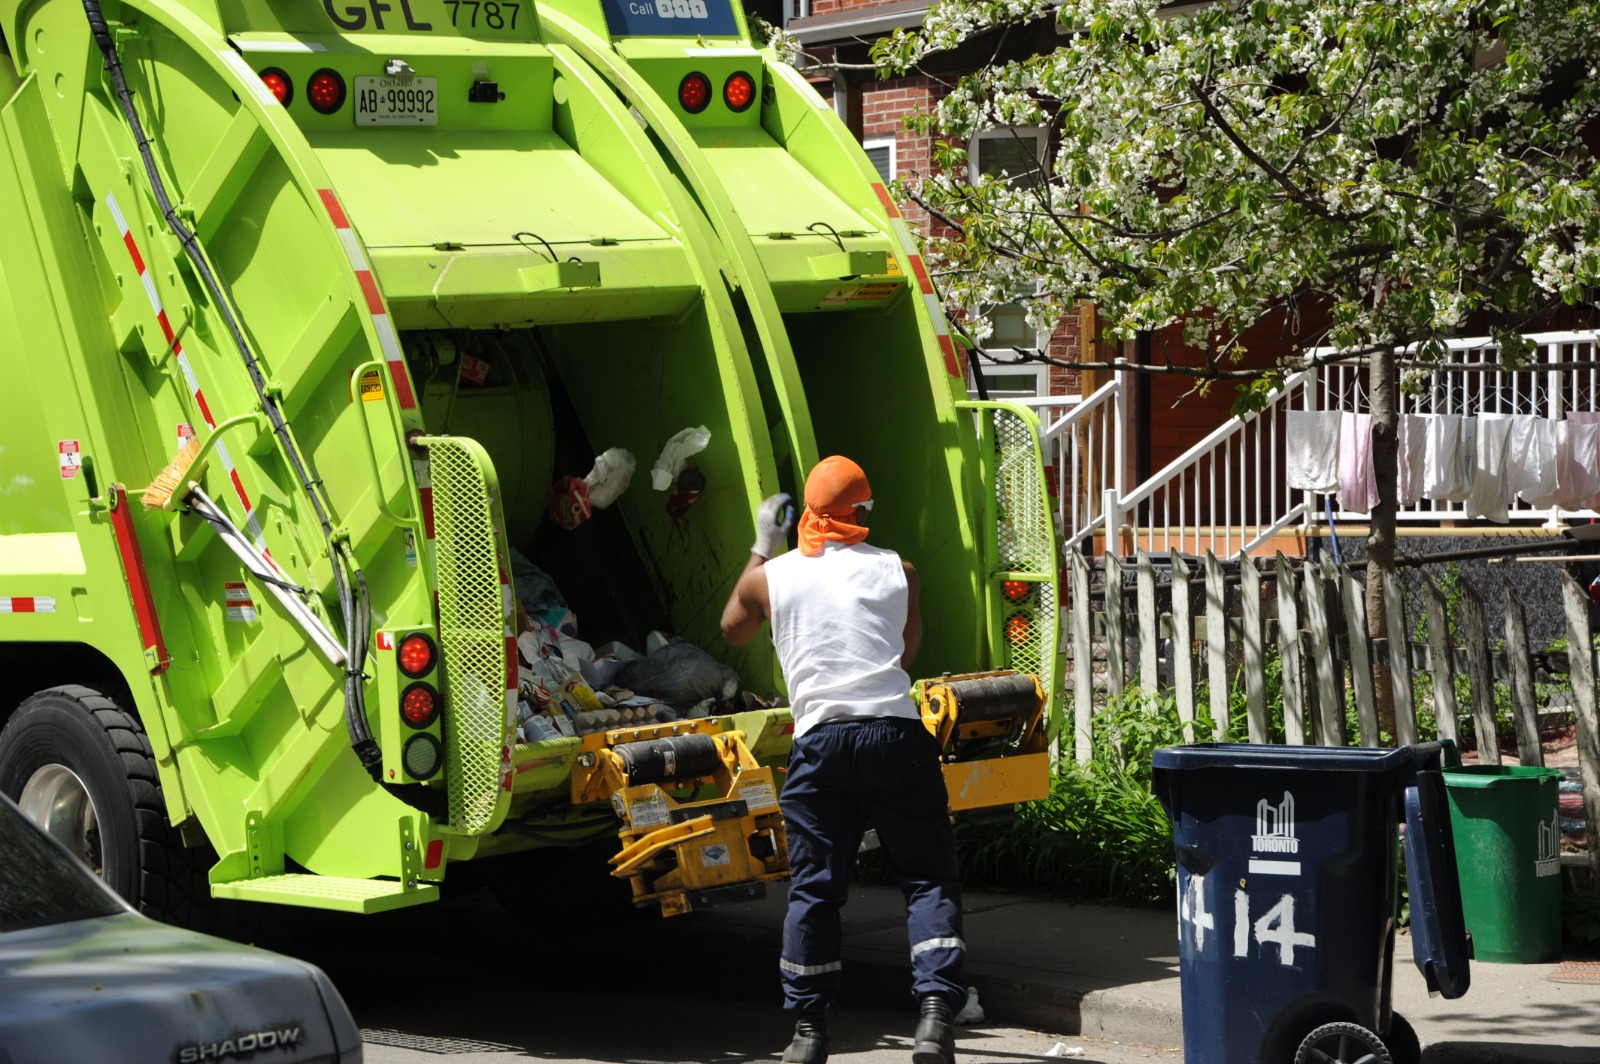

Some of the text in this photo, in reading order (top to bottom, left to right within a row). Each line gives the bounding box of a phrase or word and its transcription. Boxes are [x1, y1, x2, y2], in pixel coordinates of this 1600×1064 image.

[322, 0, 520, 31] GFL 7787
[629, 2, 654, 15] Call
[1252, 836, 1299, 853] TORONTO
[1233, 888, 1316, 966] 14
[180, 1027, 299, 1063] SHADOW
